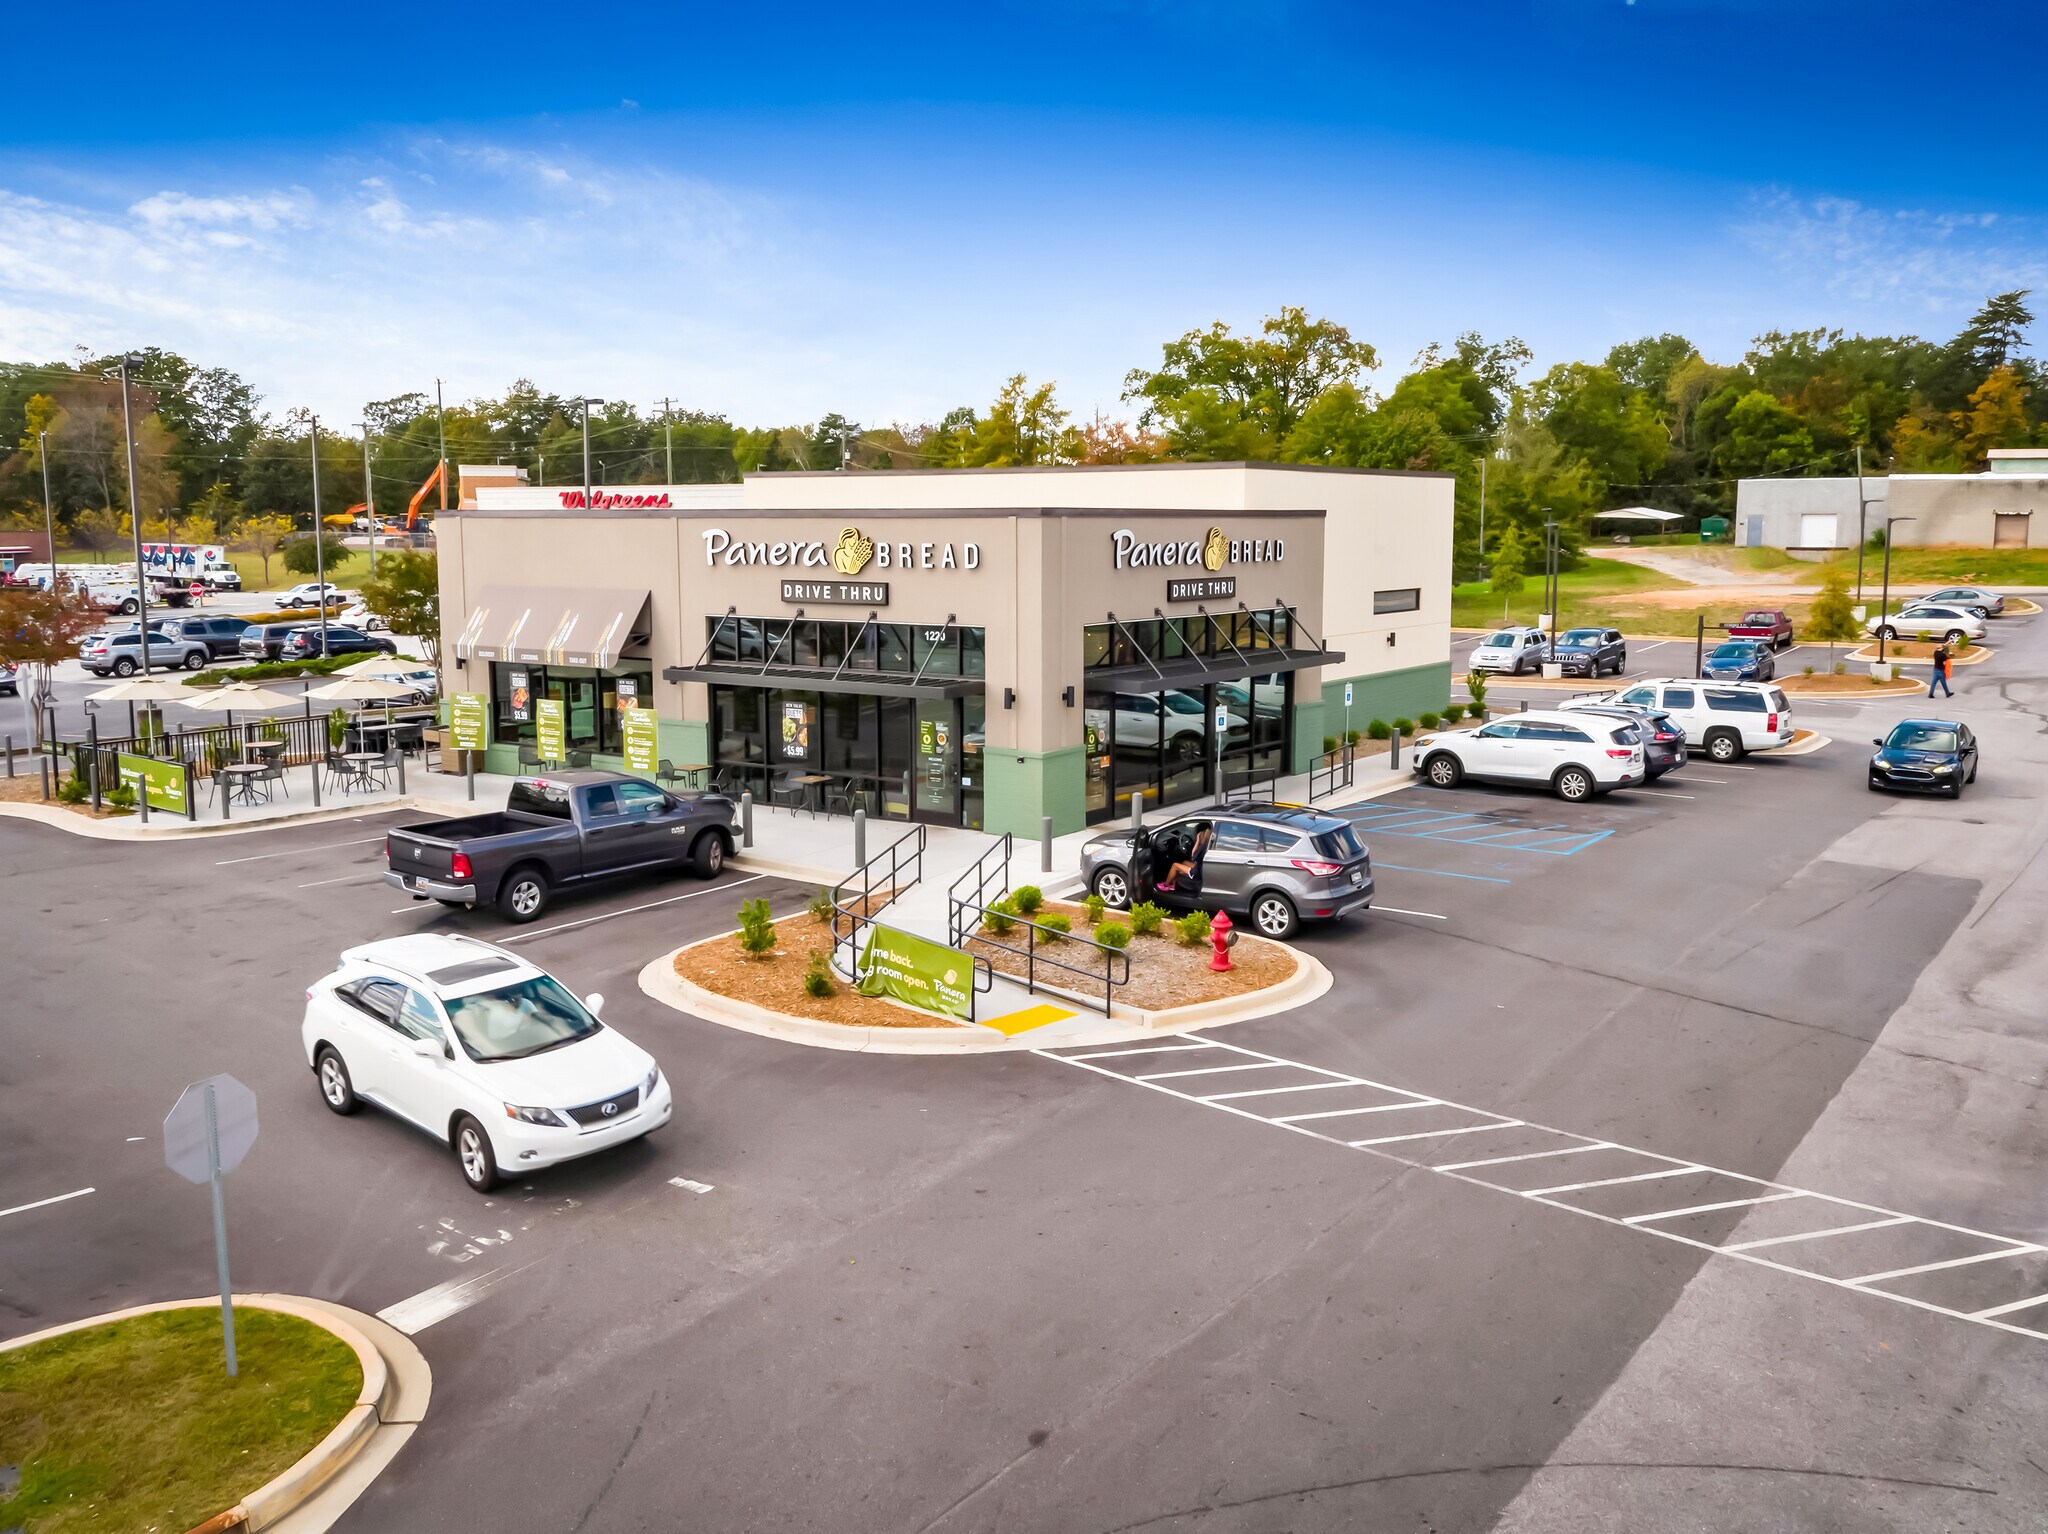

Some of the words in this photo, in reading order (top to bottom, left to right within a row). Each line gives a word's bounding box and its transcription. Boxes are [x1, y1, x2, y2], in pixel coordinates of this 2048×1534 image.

[701, 528, 829, 567] Panera
[877, 541, 981, 570] BREAD
[1111, 528, 1202, 570] Panera
[1229, 539, 1285, 563] BREAD
[783, 583, 832, 600] DRIVE
[839, 585, 884, 602] THRU
[1172, 582, 1204, 598] DRIVE
[1208, 580, 1234, 595] THRU
[514, 710, 528, 720] $5.99
[786, 745, 804, 757] $5.99
[889, 949, 914, 969] back.
[876, 965, 902, 981] room
[903, 973, 929, 991] open.
[933, 978, 966, 1001] Panera
